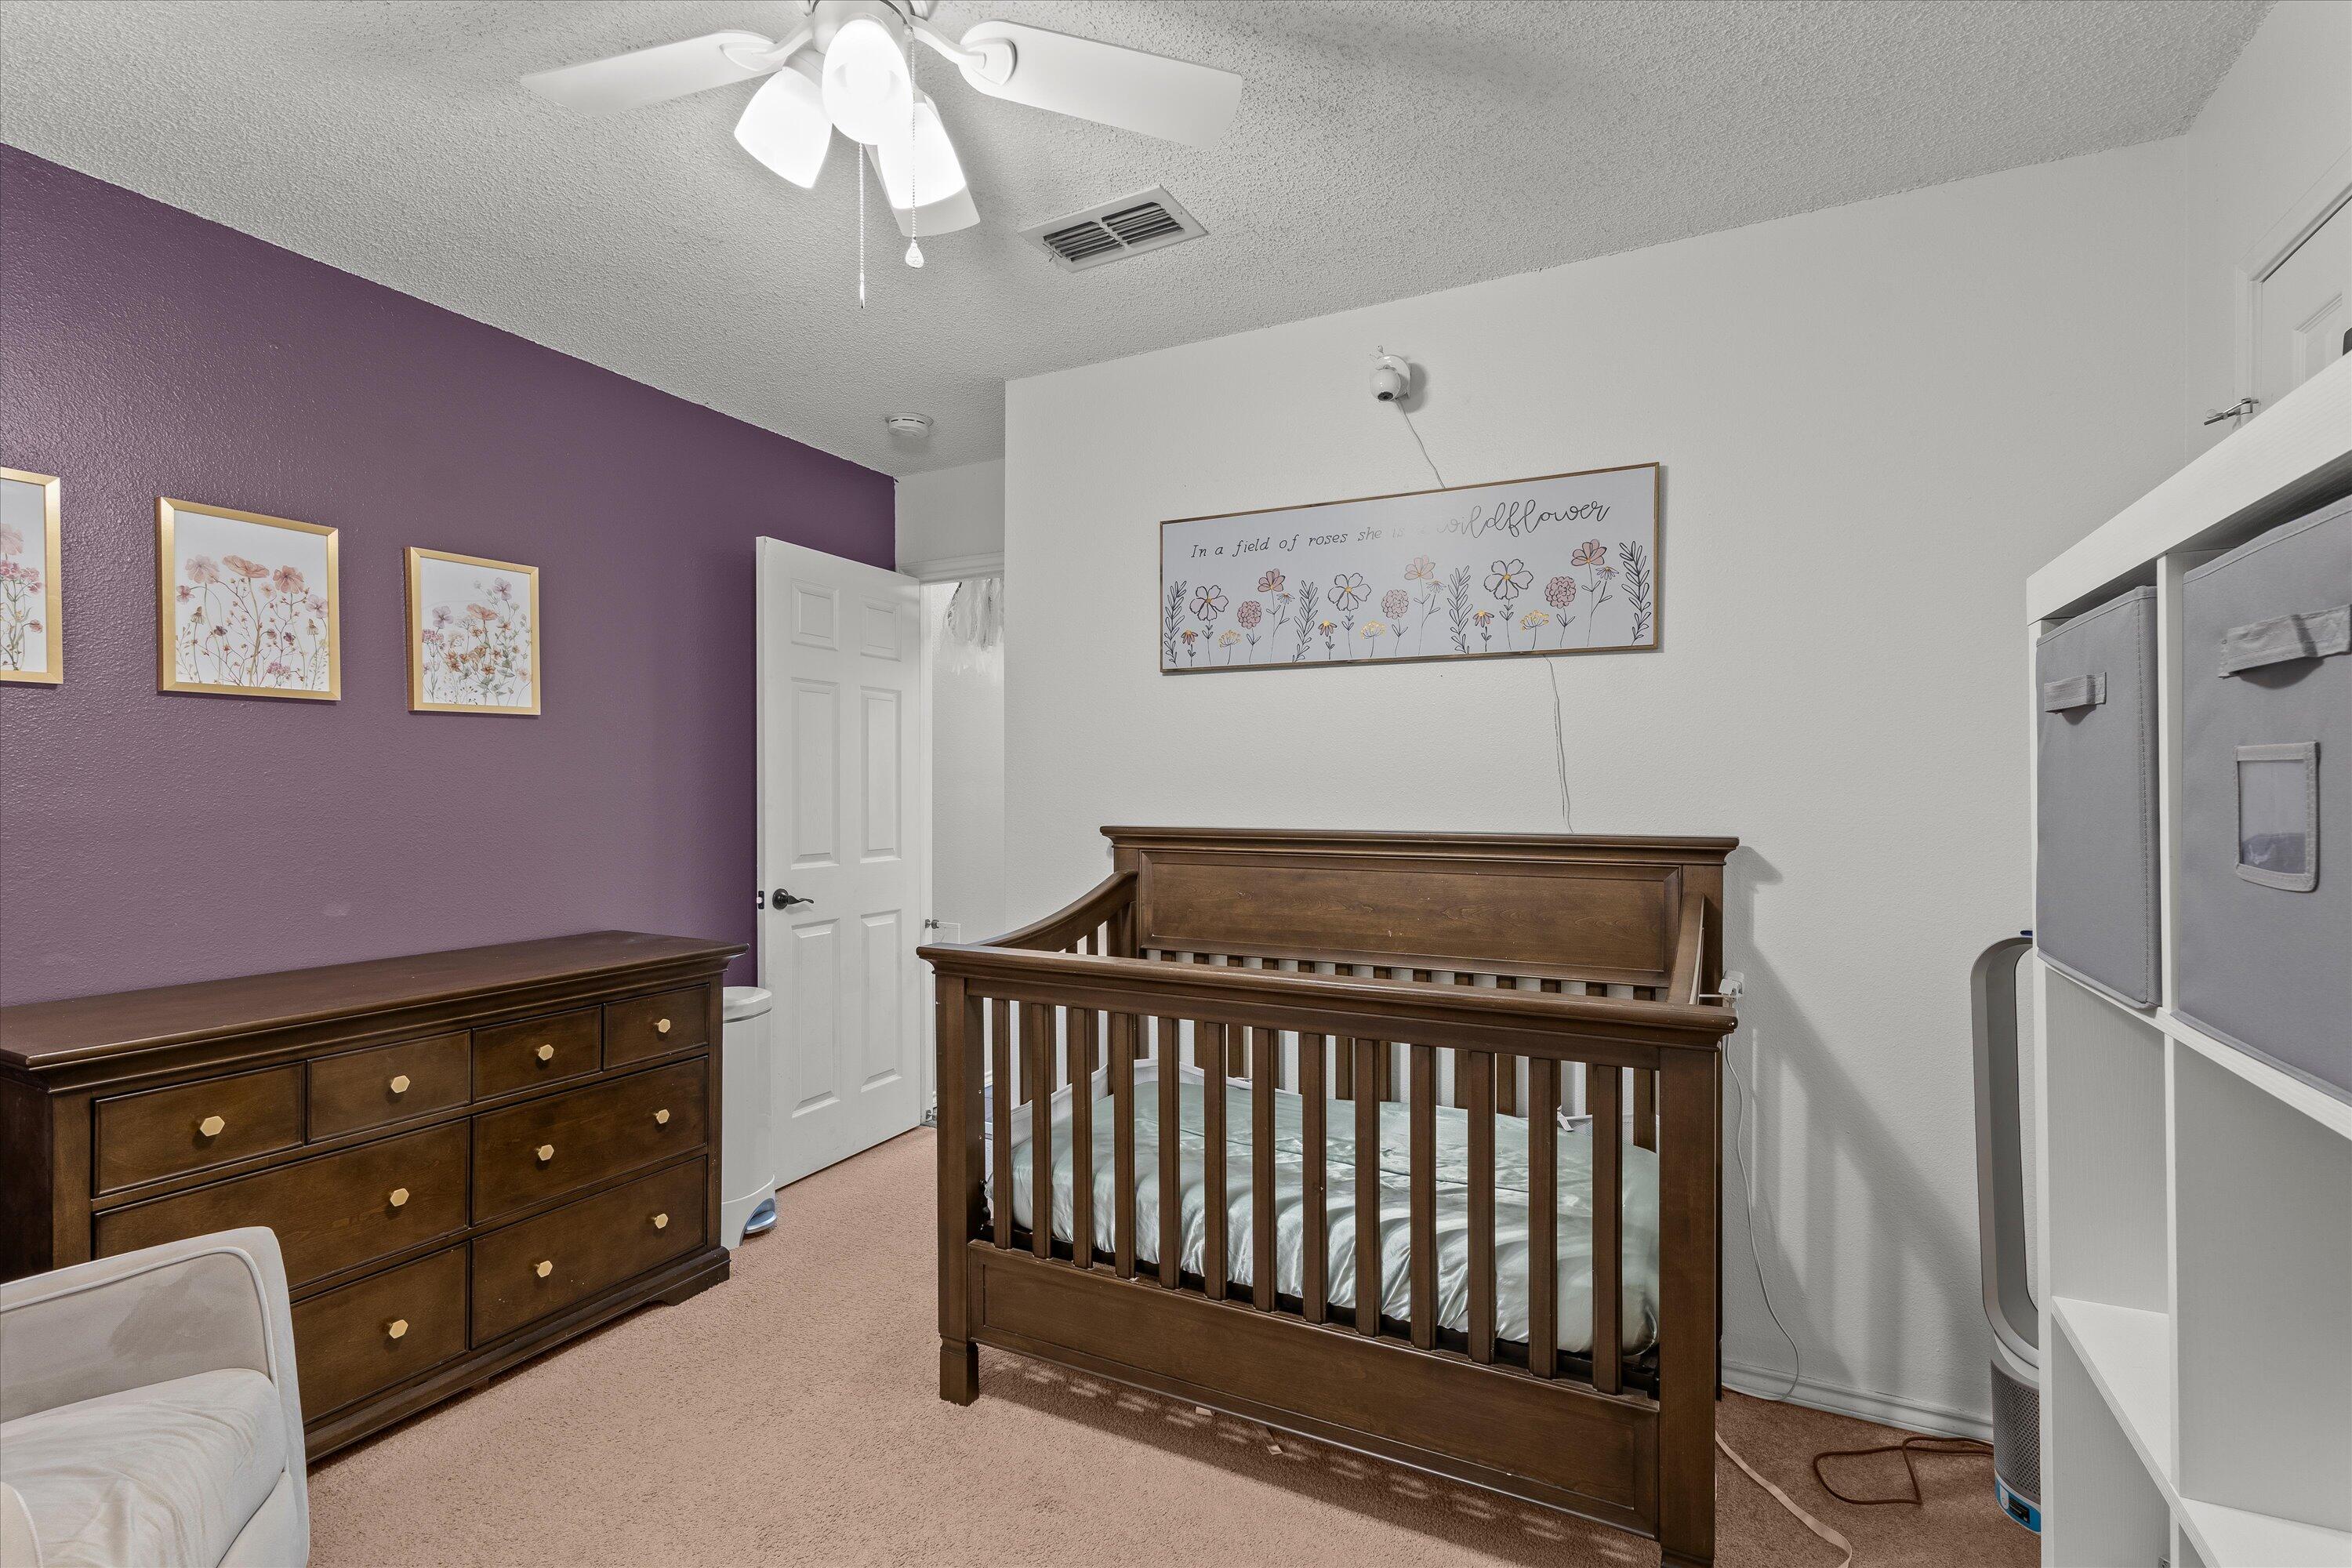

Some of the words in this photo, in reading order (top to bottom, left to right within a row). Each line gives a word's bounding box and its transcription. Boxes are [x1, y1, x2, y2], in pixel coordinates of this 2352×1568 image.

[1190, 544, 1207, 558] In
[1214, 545, 1224, 556] a
[1232, 537, 1270, 557] field
[1279, 534, 1299, 552] of
[1308, 532, 1348, 546] roses
[1357, 527, 1382, 542] she
[1437, 499, 1611, 539] wildflower
